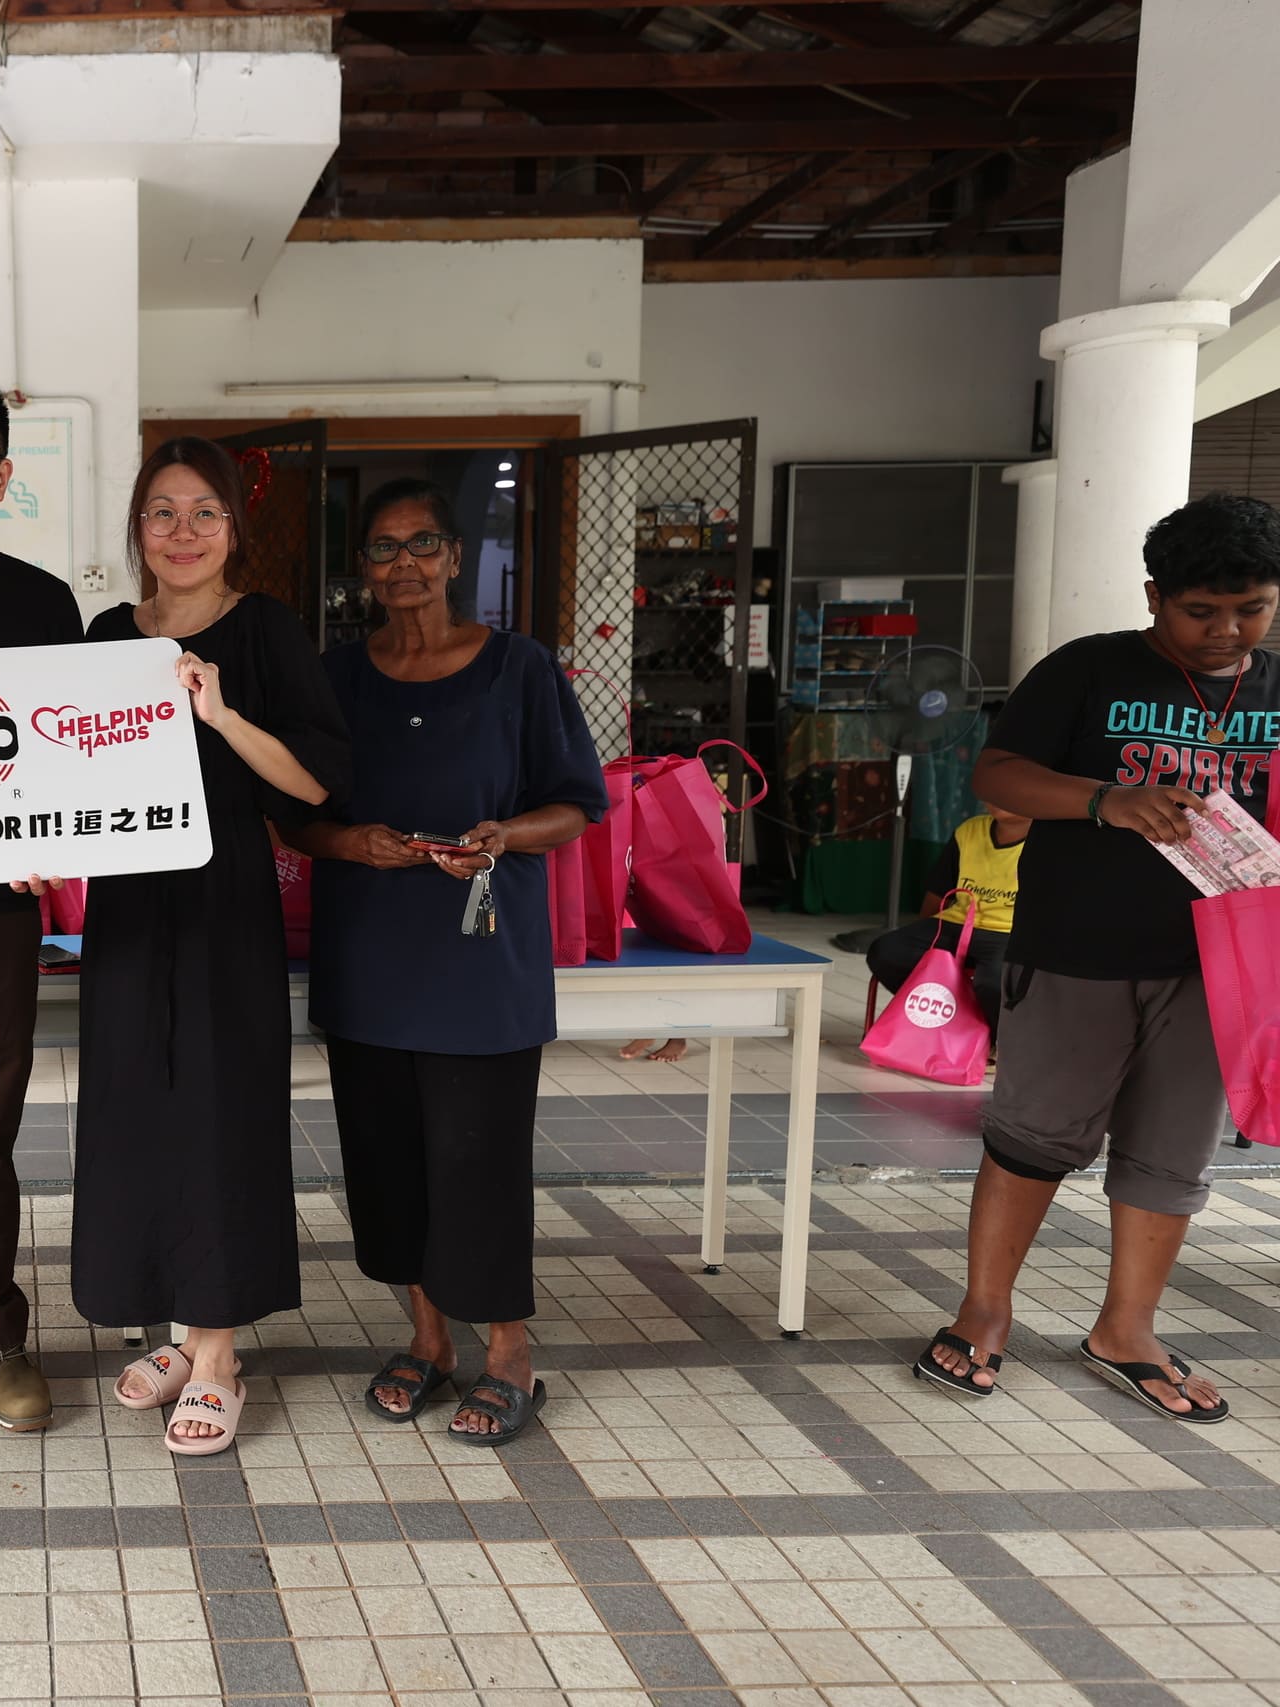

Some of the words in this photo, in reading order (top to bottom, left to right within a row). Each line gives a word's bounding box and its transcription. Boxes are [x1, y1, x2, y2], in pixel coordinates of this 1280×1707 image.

[19, 446, 62, 454] PREMISE
[57, 701, 175, 739] HELPING
[78, 725, 150, 757] HANDS
[1116, 742, 1269, 797] SPIRIT
[29, 811, 63, 838] IT!
[907, 994, 954, 1019] TOTO
[178, 1396, 226, 1414] ellesse
